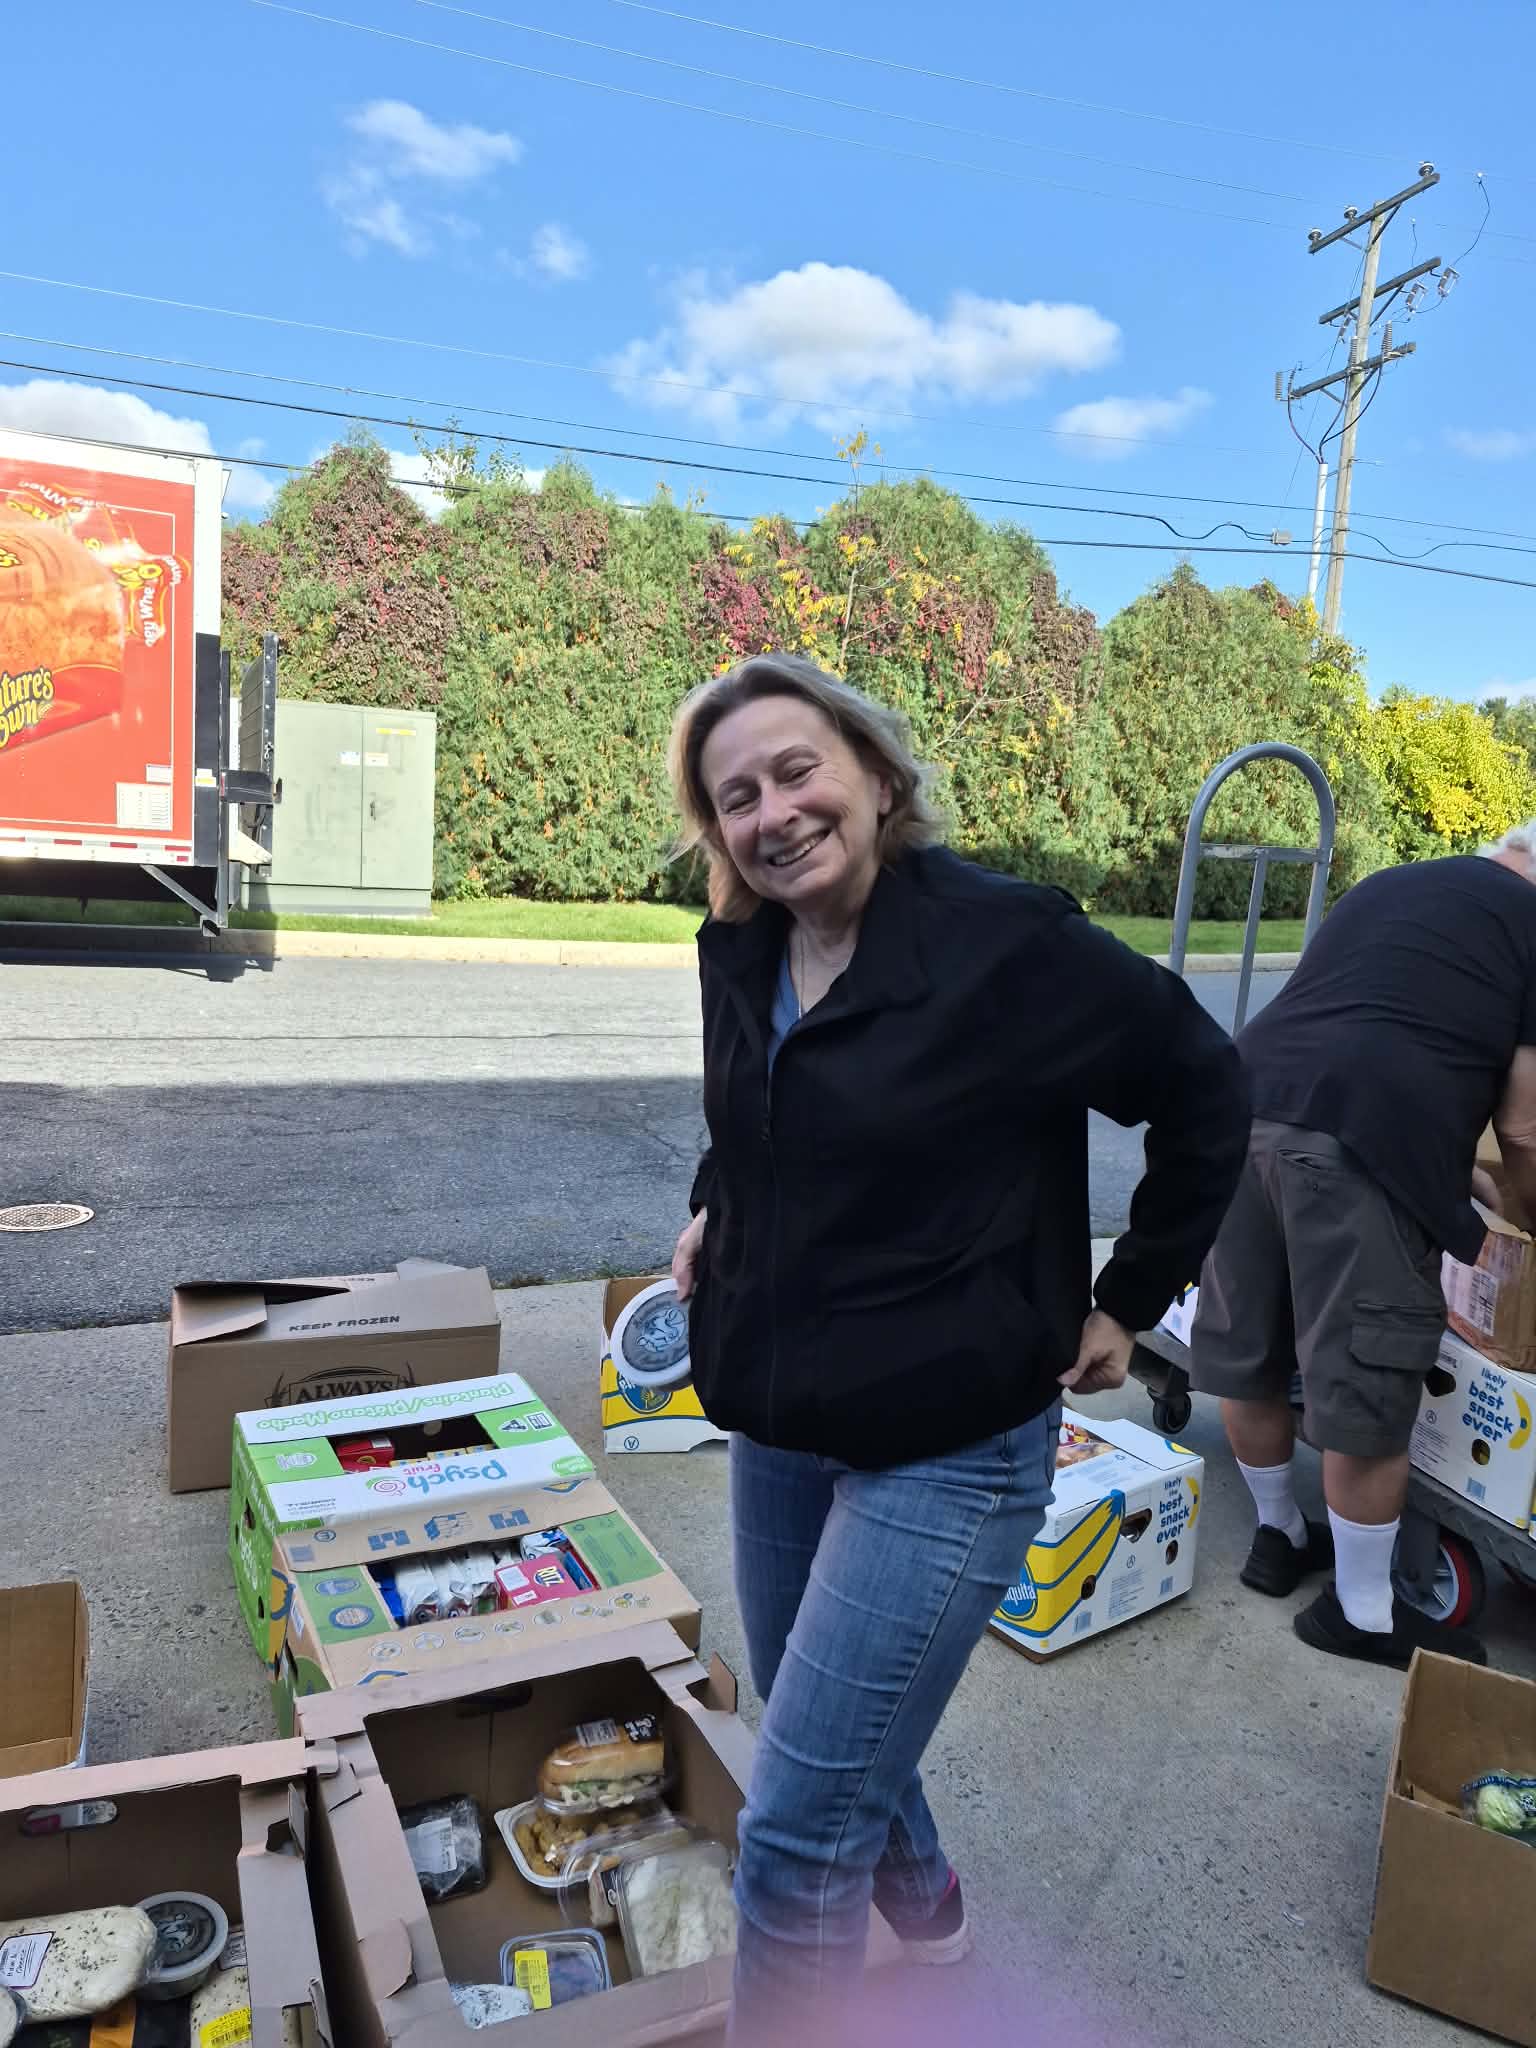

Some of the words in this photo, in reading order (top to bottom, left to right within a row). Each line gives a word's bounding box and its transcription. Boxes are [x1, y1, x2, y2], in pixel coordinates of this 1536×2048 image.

[0, 667, 53, 713] ture's
[289, 1322, 332, 1332] KEEP
[337, 1315, 400, 1328] FROZEN
[1481, 1368, 1507, 1387] likely
[295, 1380, 393, 1402] ALWAYS
[1469, 1381, 1505, 1410] best
[1462, 1413, 1503, 1442] ever
[1469, 1400, 1514, 1434] snack
[1164, 1476, 1182, 1490] likely
[1159, 1494, 1184, 1515] best
[1160, 1505, 1190, 1528] snack
[1156, 1522, 1184, 1544] ever
[536, 1565, 565, 1586] RITZ
[1004, 1583, 1037, 1606] iquita
